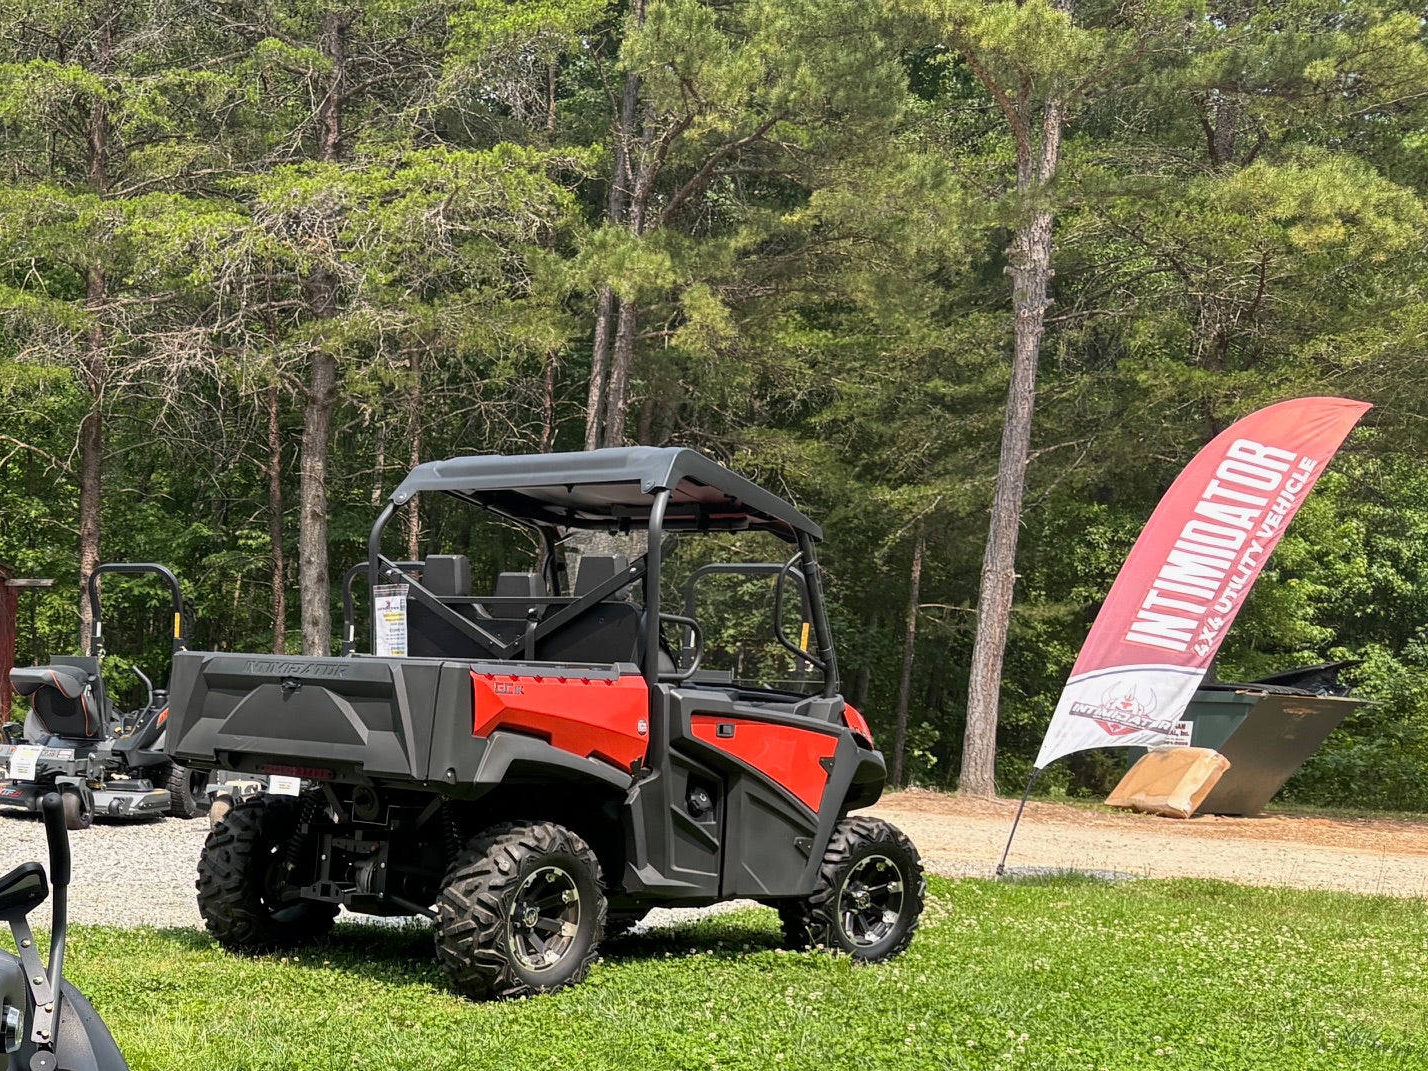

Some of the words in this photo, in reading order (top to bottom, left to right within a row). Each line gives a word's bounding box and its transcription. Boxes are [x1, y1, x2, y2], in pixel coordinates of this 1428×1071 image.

[1124, 438, 1297, 651] INTIMIDATOR
[1214, 538, 1264, 614] UTILITY
[1256, 456, 1318, 538] VEHICLE
